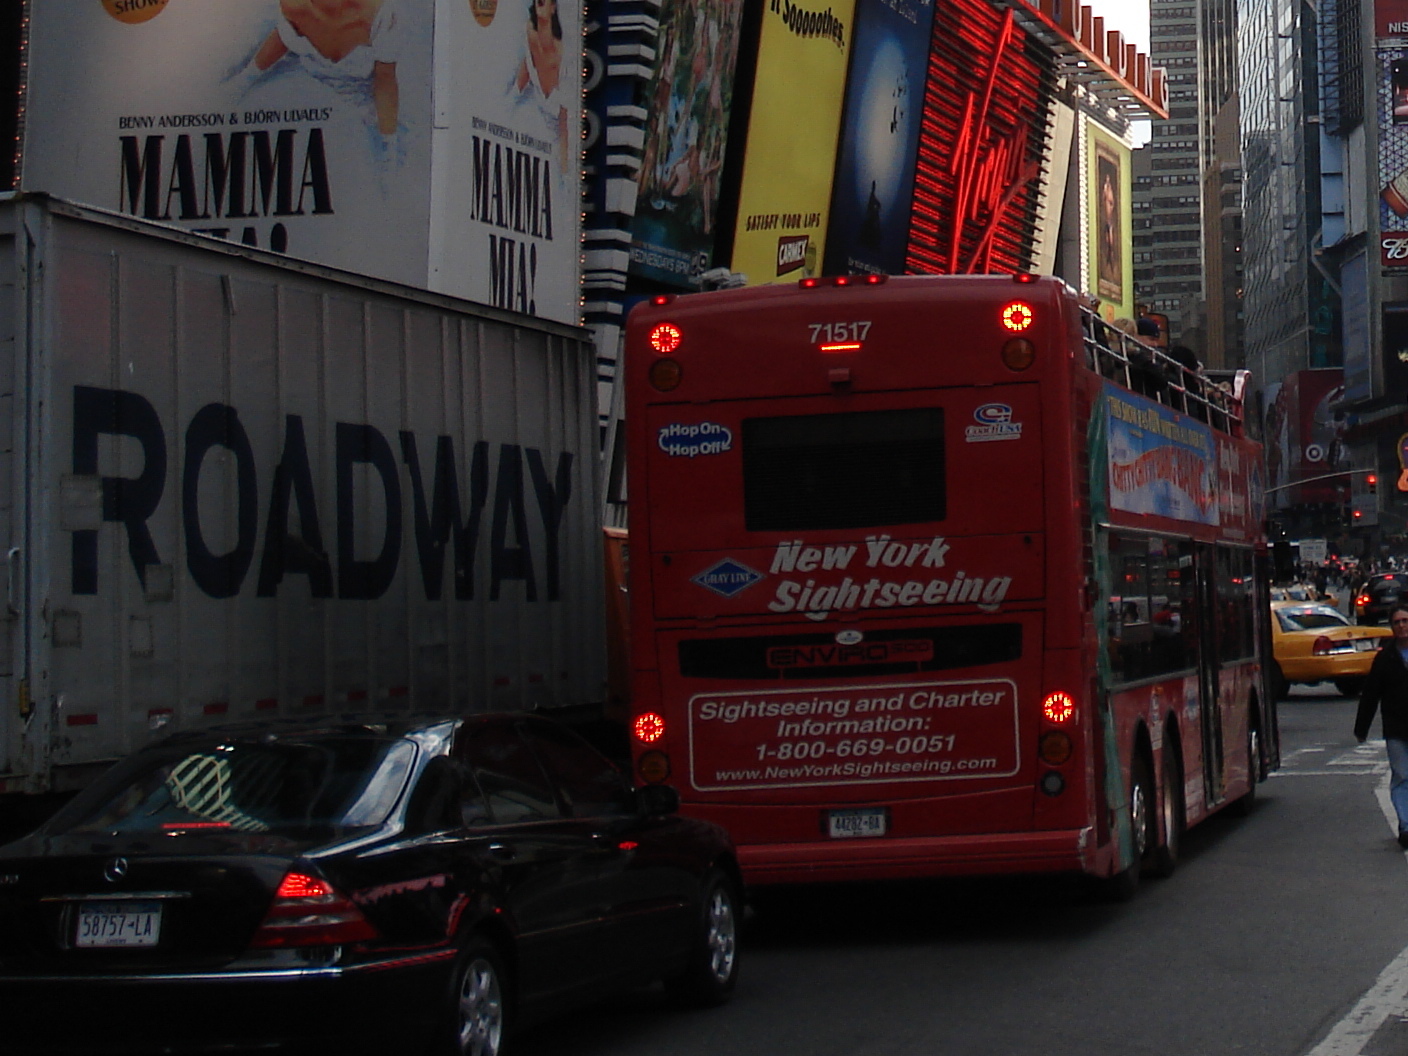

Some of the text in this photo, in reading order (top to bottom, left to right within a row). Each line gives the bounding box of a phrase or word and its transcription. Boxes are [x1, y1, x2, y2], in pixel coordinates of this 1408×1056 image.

[119, 115, 157, 129] BENNY
[158, 112, 225, 128] ANDERSSON
[229, 113, 239, 126] &
[119, 128, 335, 221] MAMMA
[470, 135, 553, 241] MAMMA
[746, 214, 779, 232] SATISFY
[803, 213, 821, 229] LIPS
[488, 233, 537, 317] MIA!
[808, 320, 872, 344] 71517
[669, 422, 721, 438] Hop On
[669, 441, 722, 457] Hop Off
[72, 384, 574, 603] ROADWAY
[769, 534, 951, 575] New York
[703, 572, 729, 585] GRAY
[767, 570, 1013, 621] Sightseeing
[770, 645, 888, 666] ENVIRO
[699, 689, 1006, 723] Sightseeing and Charter
[776, 715, 932, 738] Information:
[756, 734, 956, 761] 1-800-669-0051
[715, 756, 998, 782] www.NewYorkSightseeing.com
